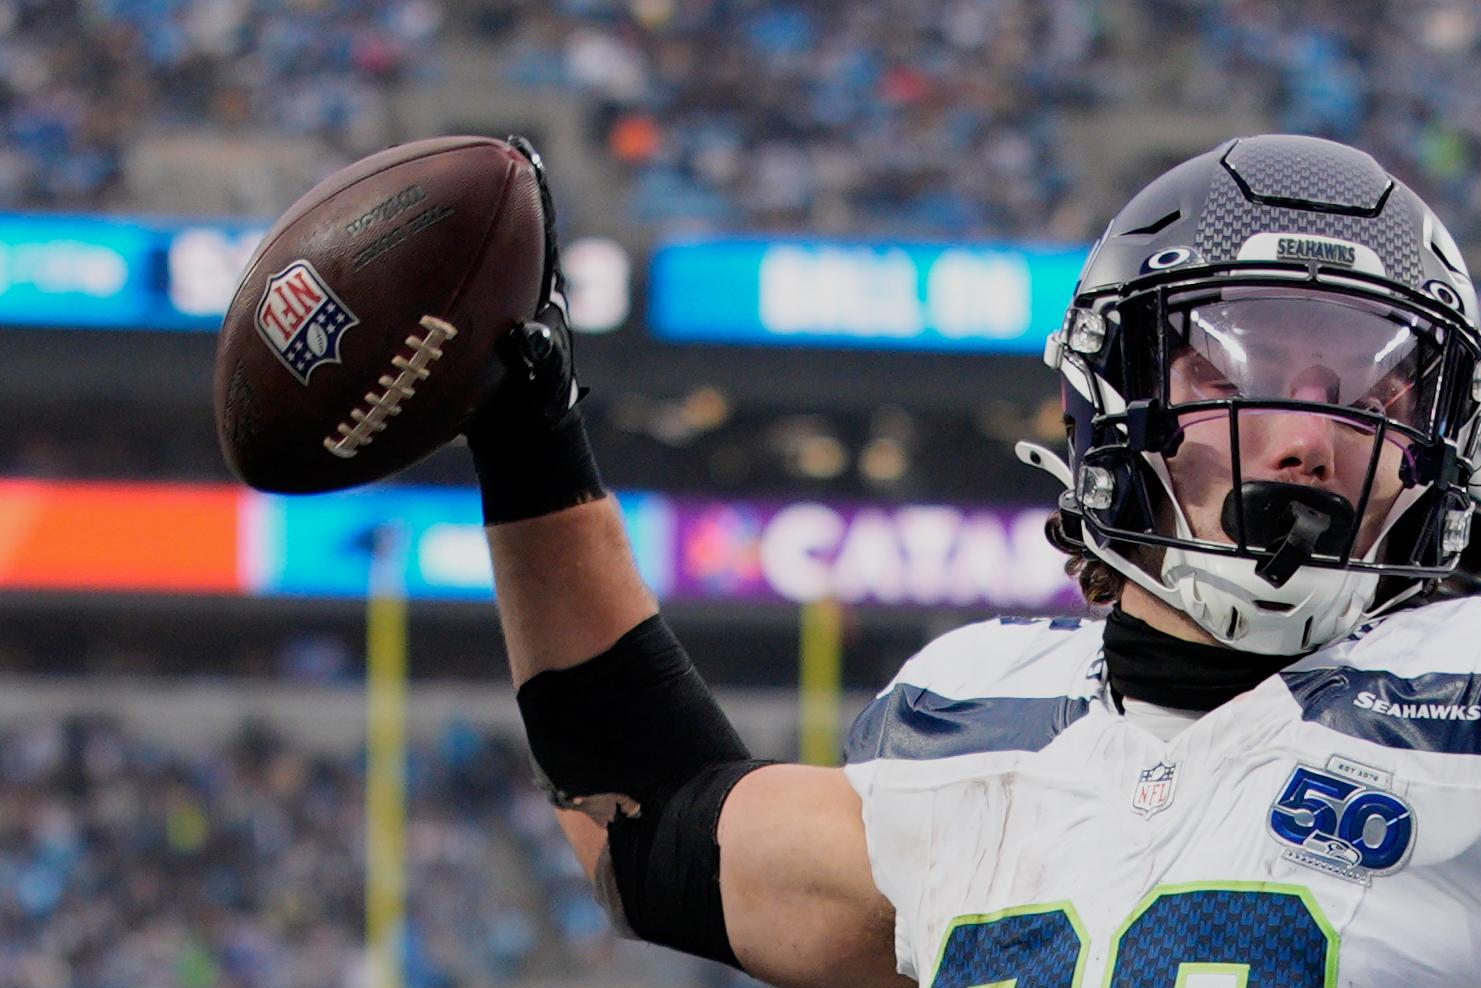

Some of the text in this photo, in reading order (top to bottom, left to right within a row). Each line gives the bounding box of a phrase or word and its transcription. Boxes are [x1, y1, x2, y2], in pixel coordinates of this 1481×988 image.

[1277, 238, 1355, 263] SEAHAWKS
[262, 271, 322, 343] NFL
[1353, 691, 1481, 721] SEAHAWKS
[1137, 783, 1168, 806] NFL
[1269, 764, 1413, 871] 50
